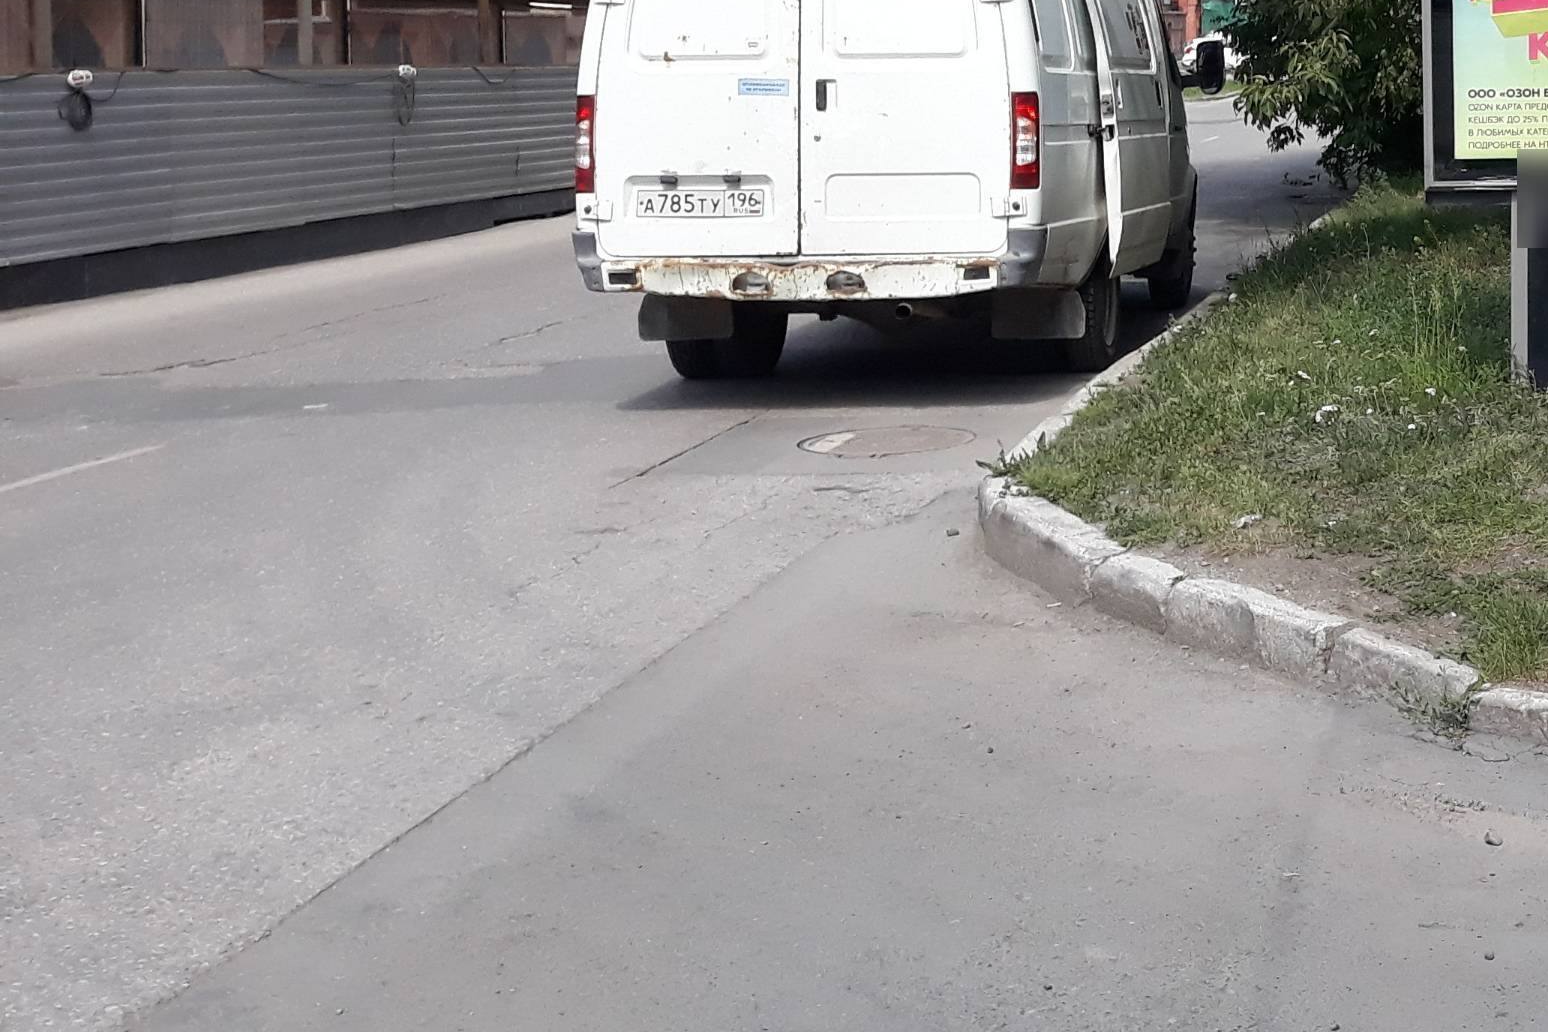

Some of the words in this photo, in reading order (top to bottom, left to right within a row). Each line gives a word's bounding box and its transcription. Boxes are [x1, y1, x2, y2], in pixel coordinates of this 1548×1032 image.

[1467, 88, 1496, 99] ООО
[1499, 88, 1541, 99] «ОЗОН
[1468, 102, 1494, 112] OZON
[1495, 102, 1522, 111] КАРТА
[1467, 115, 1505, 125] КЕШБЭК
[1506, 115, 1521, 125] ДО
[1467, 128, 1475, 137] В
[1476, 127, 1524, 138] ЛЮБИМЫХ
[1468, 140, 1521, 150] ПОДРОБНЕЕ
[1523, 140, 1537, 149] НА
[727, 192, 758, 208] 196
